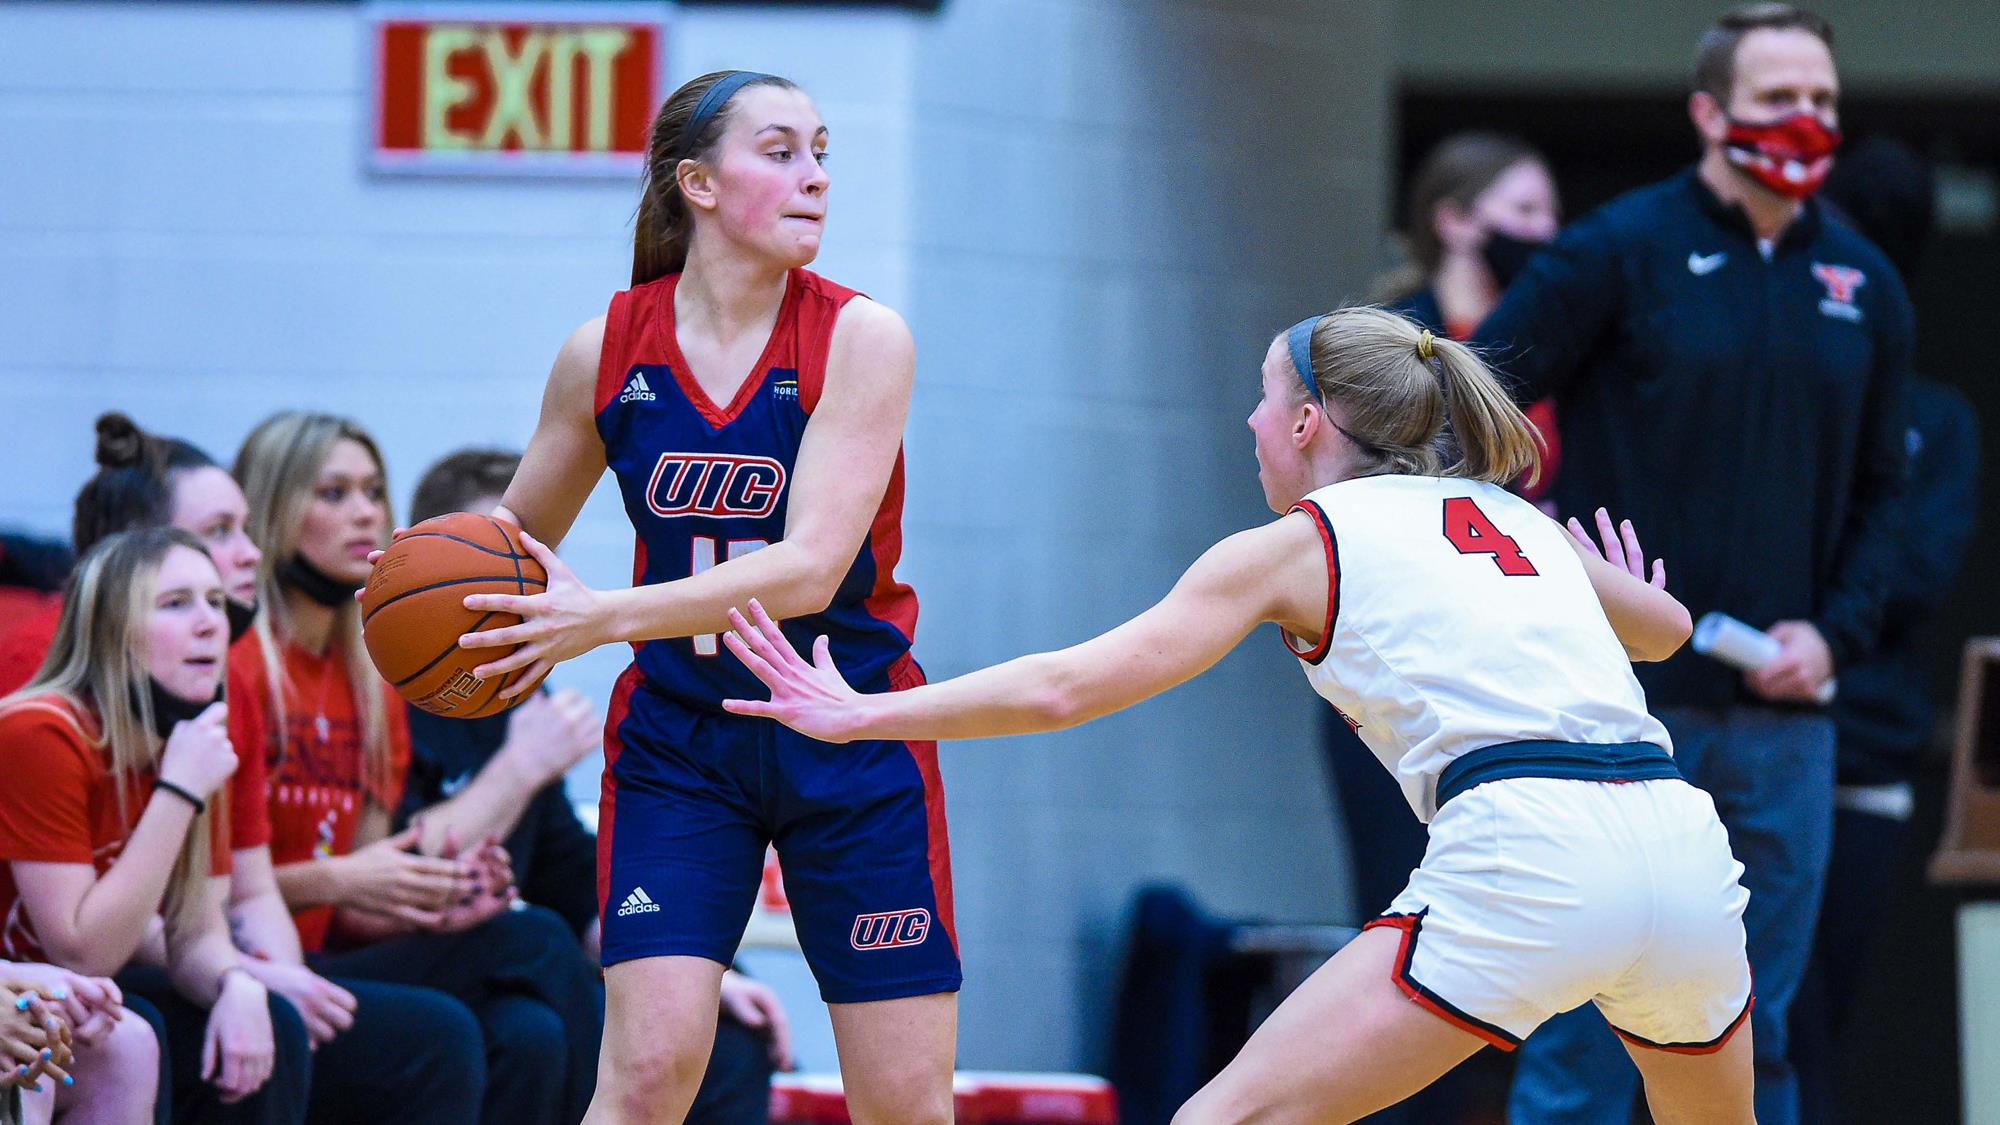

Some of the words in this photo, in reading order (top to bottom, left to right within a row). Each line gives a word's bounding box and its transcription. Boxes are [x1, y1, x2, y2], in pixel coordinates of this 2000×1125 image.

[424, 28, 630, 151] EXIT
[620, 390, 656, 403] adidas
[646, 452, 786, 518] UIC
[1442, 496, 1540, 576] 4
[690, 535, 781, 658] 1
[617, 903, 660, 916] adidas
[850, 908, 931, 951] UIC
